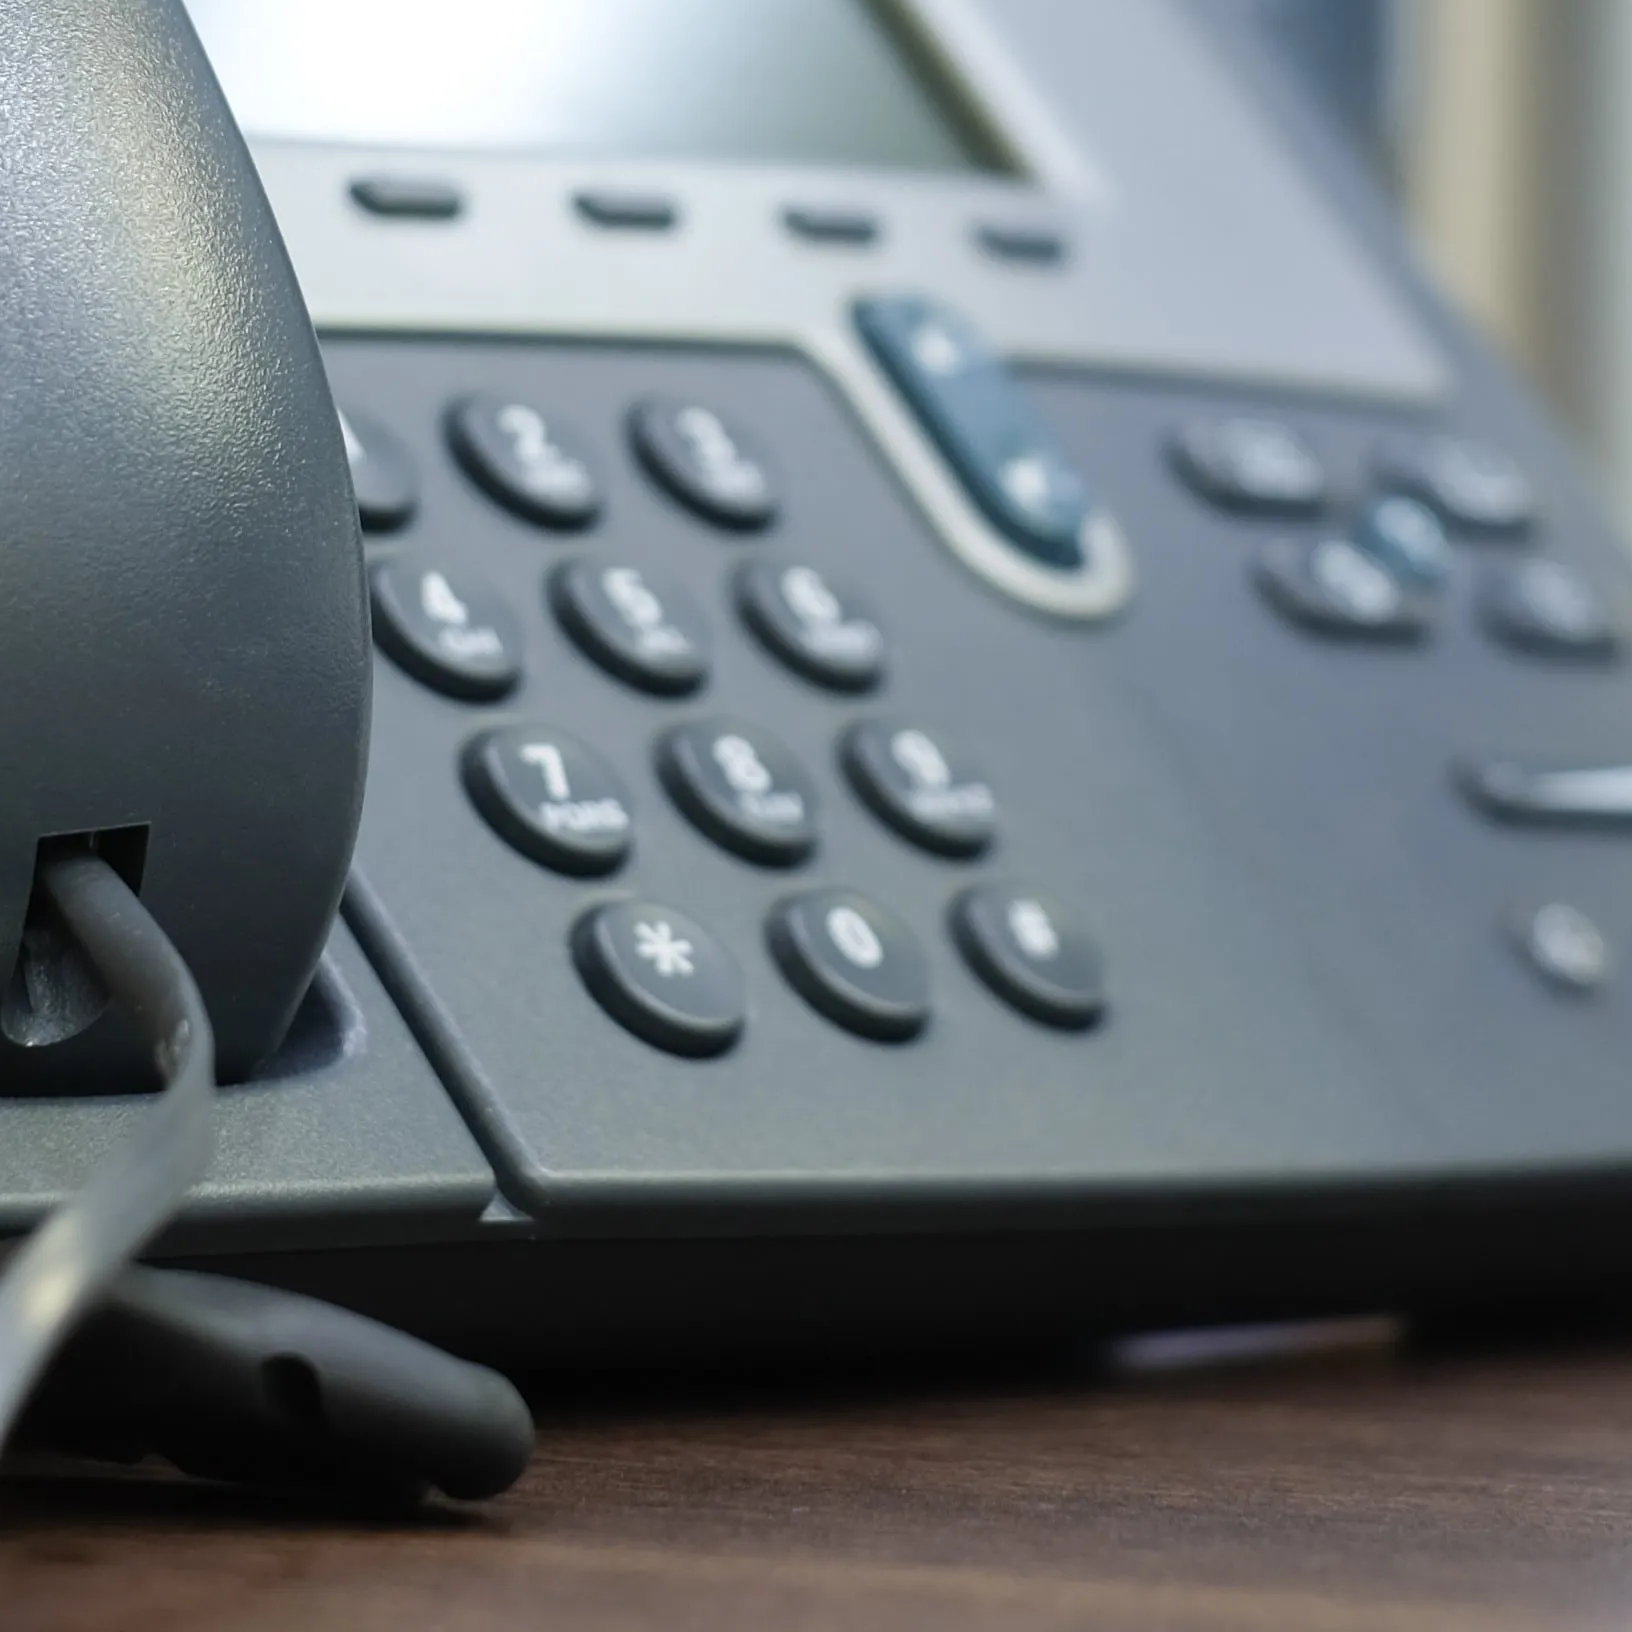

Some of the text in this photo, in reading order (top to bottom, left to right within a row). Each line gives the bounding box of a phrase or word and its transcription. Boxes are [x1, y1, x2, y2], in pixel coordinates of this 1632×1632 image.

[421, 570, 468, 624] 4
[604, 567, 663, 628] 5
[519, 744, 570, 800] 7
[712, 736, 773, 792] 8
[826, 906, 883, 969] 0
